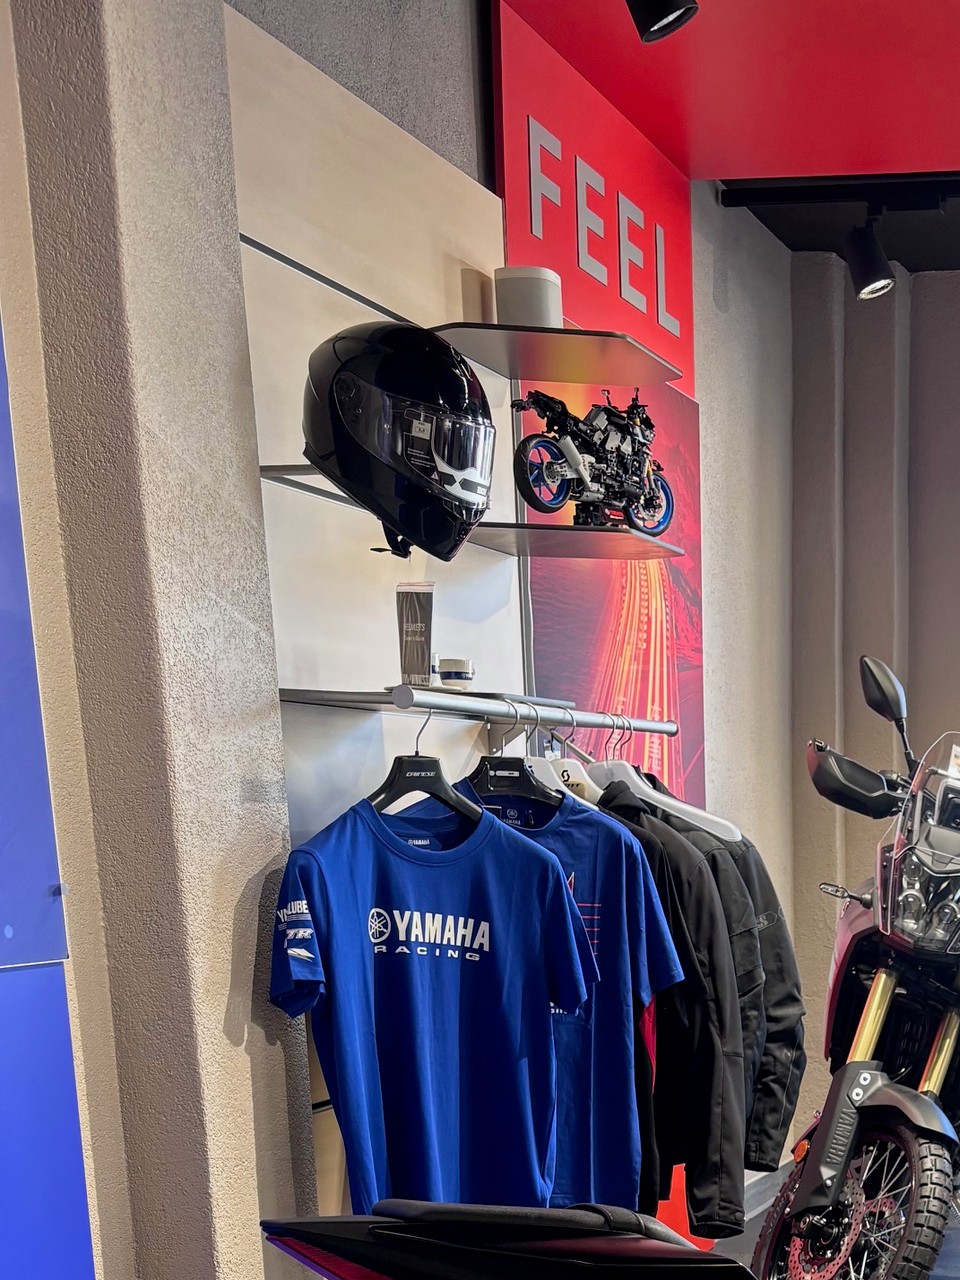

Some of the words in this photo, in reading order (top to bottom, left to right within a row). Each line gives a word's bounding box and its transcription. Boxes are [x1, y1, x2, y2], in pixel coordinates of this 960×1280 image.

[527, 114, 680, 338] FEEL
[374, 945, 480, 961] RACING
[393, 910, 490, 951] YAMAHA
[825, 1108, 857, 1164] YAMAHA
